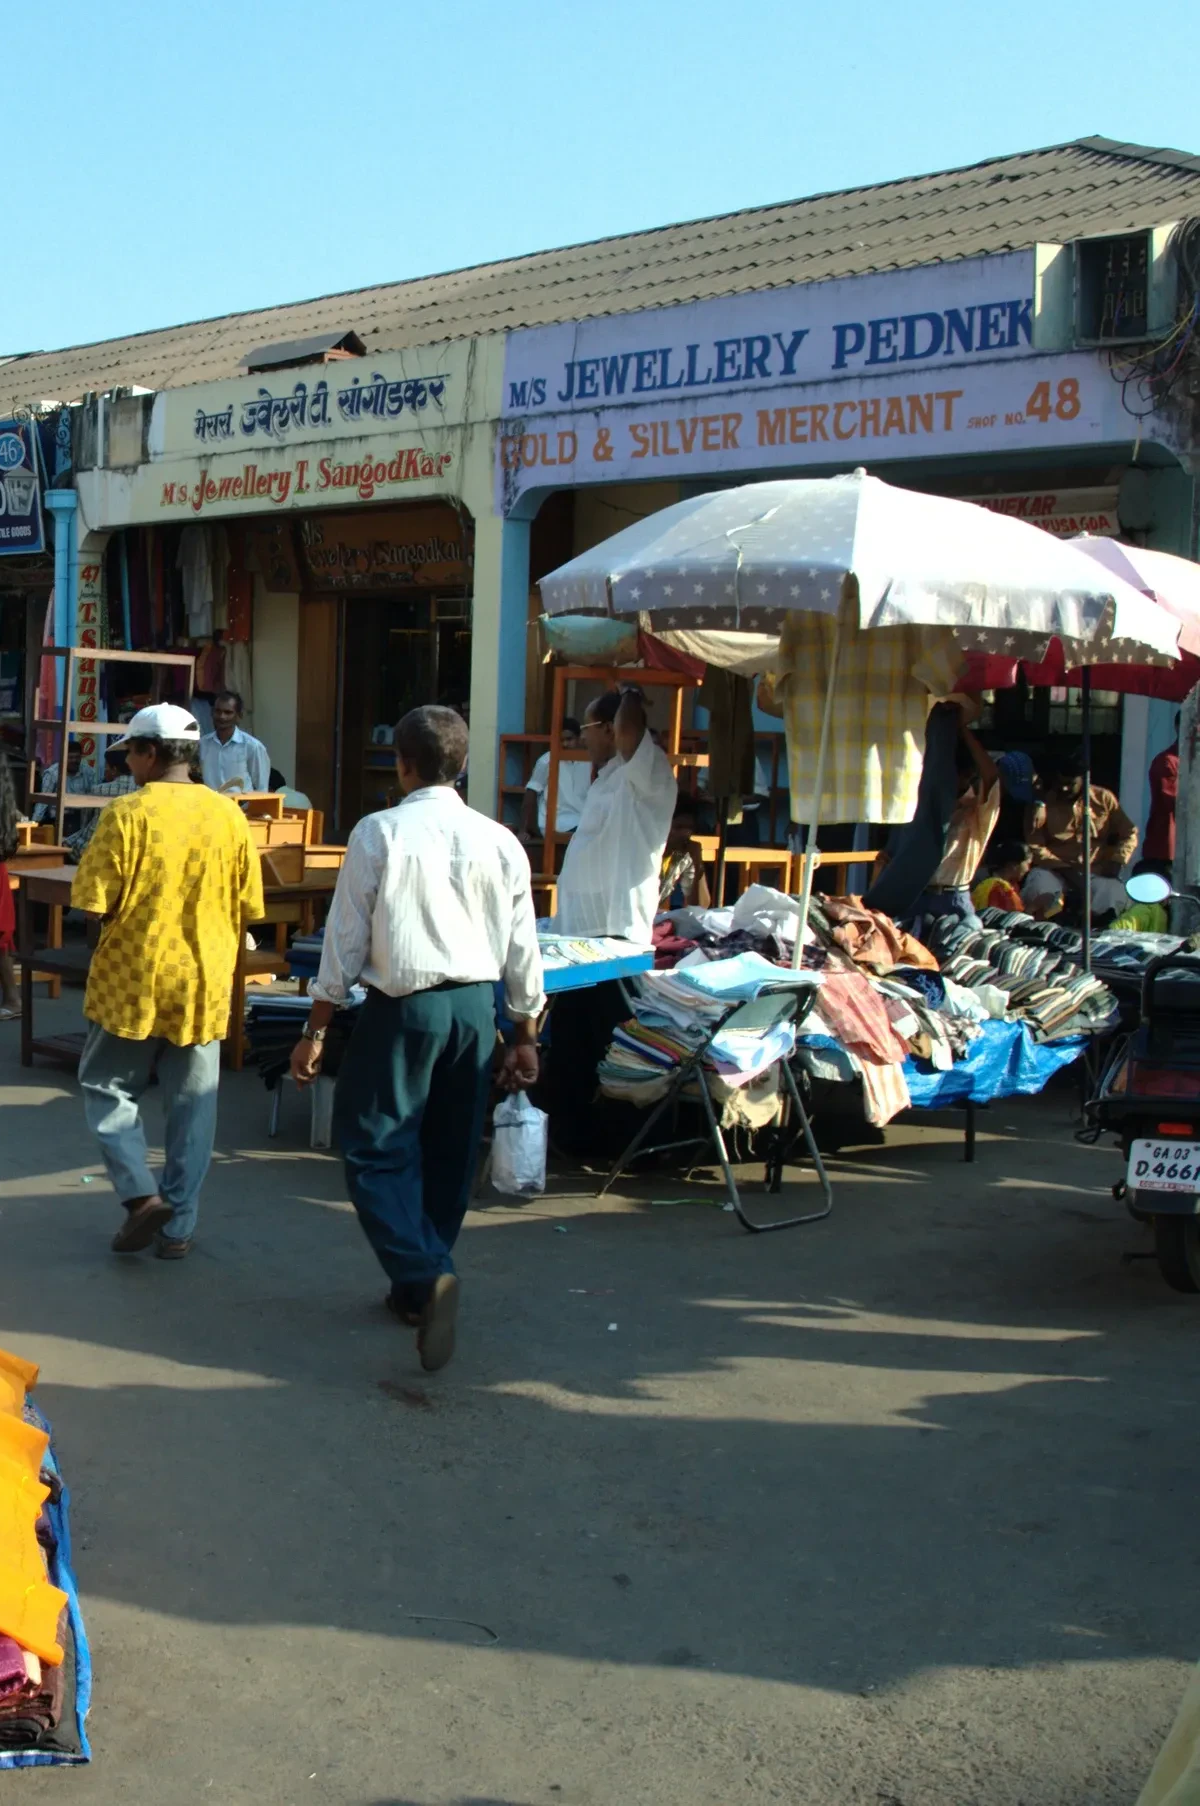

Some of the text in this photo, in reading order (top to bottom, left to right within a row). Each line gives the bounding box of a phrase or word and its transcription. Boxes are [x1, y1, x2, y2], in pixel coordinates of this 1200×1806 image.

[509, 298, 1034, 410] M/S JEWELLERY PEDNEK
[500, 430, 578, 468] GOLD
[593, 427, 615, 462] &
[628, 411, 741, 458] SILVER
[756, 390, 963, 446] MERCHANT
[966, 414, 997, 429] SHOP
[1026, 378, 1081, 422] 48
[190, 464, 292, 511] Jewellery
[79, 563, 100, 582] 47
[1153, 1147, 1191, 1160] GA 03
